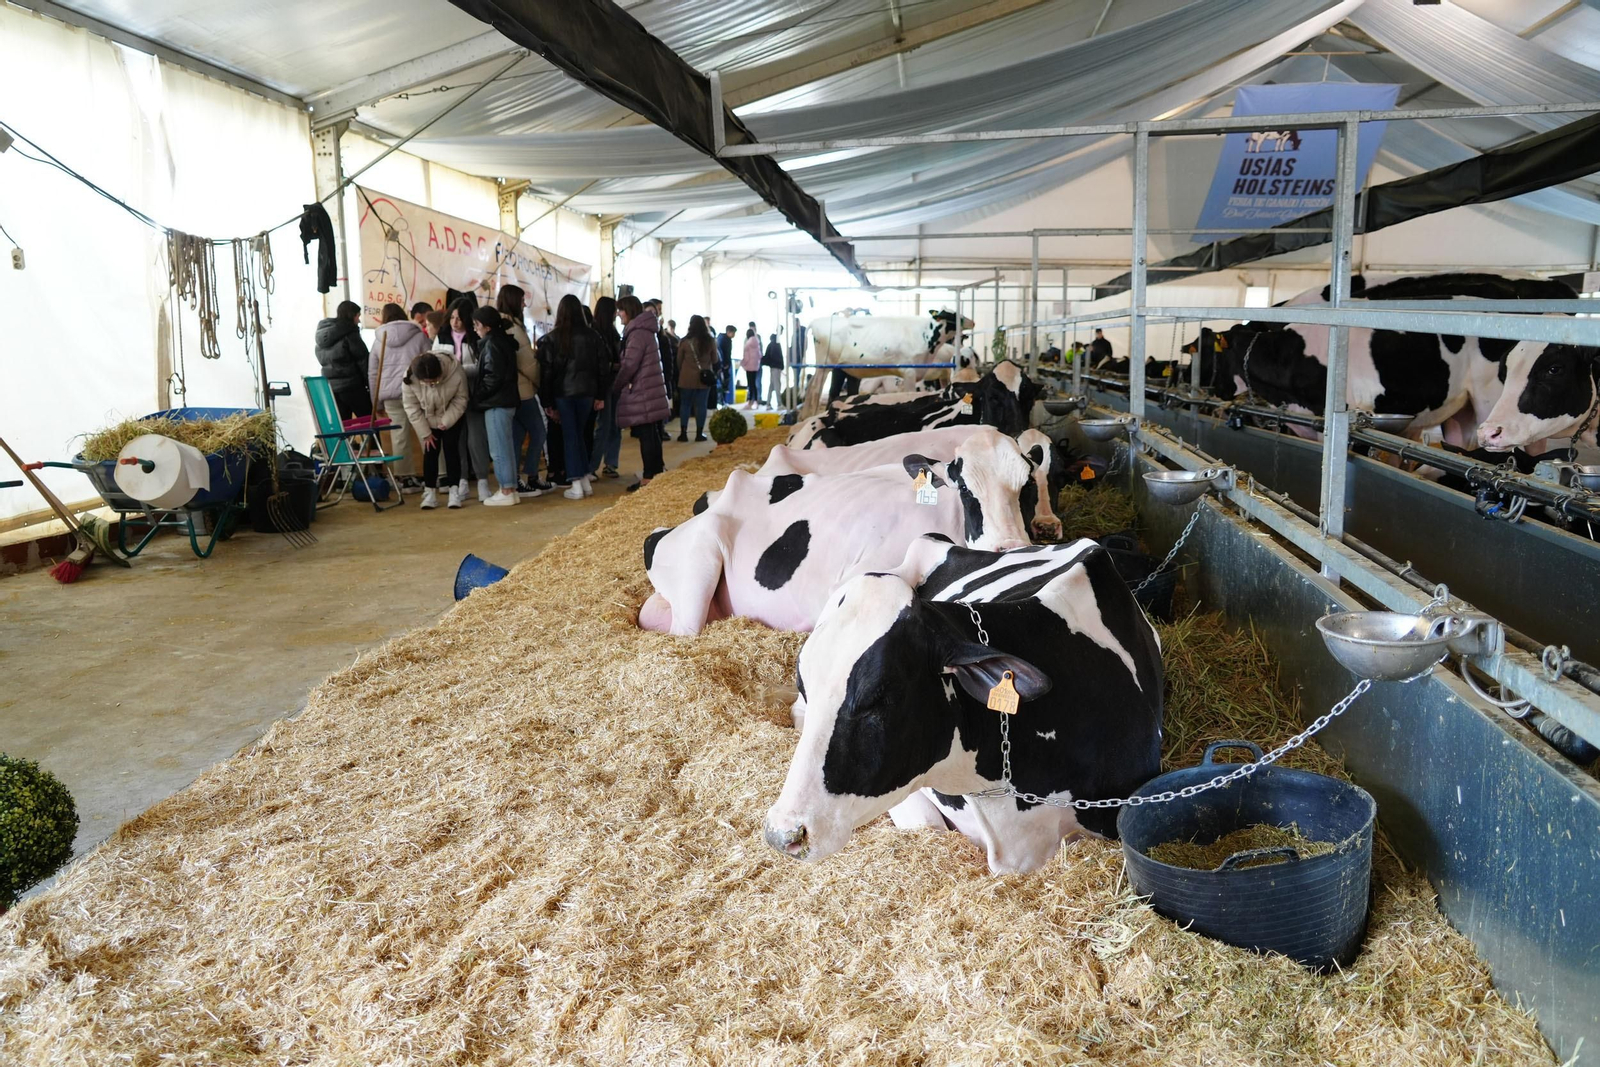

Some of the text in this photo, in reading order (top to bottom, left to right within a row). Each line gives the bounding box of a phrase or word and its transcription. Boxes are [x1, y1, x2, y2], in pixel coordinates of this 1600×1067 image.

[1239, 156, 1297, 177] USÍAS
[1232, 178, 1335, 196] HOLSTEINS
[990, 696, 1016, 714] 0178
